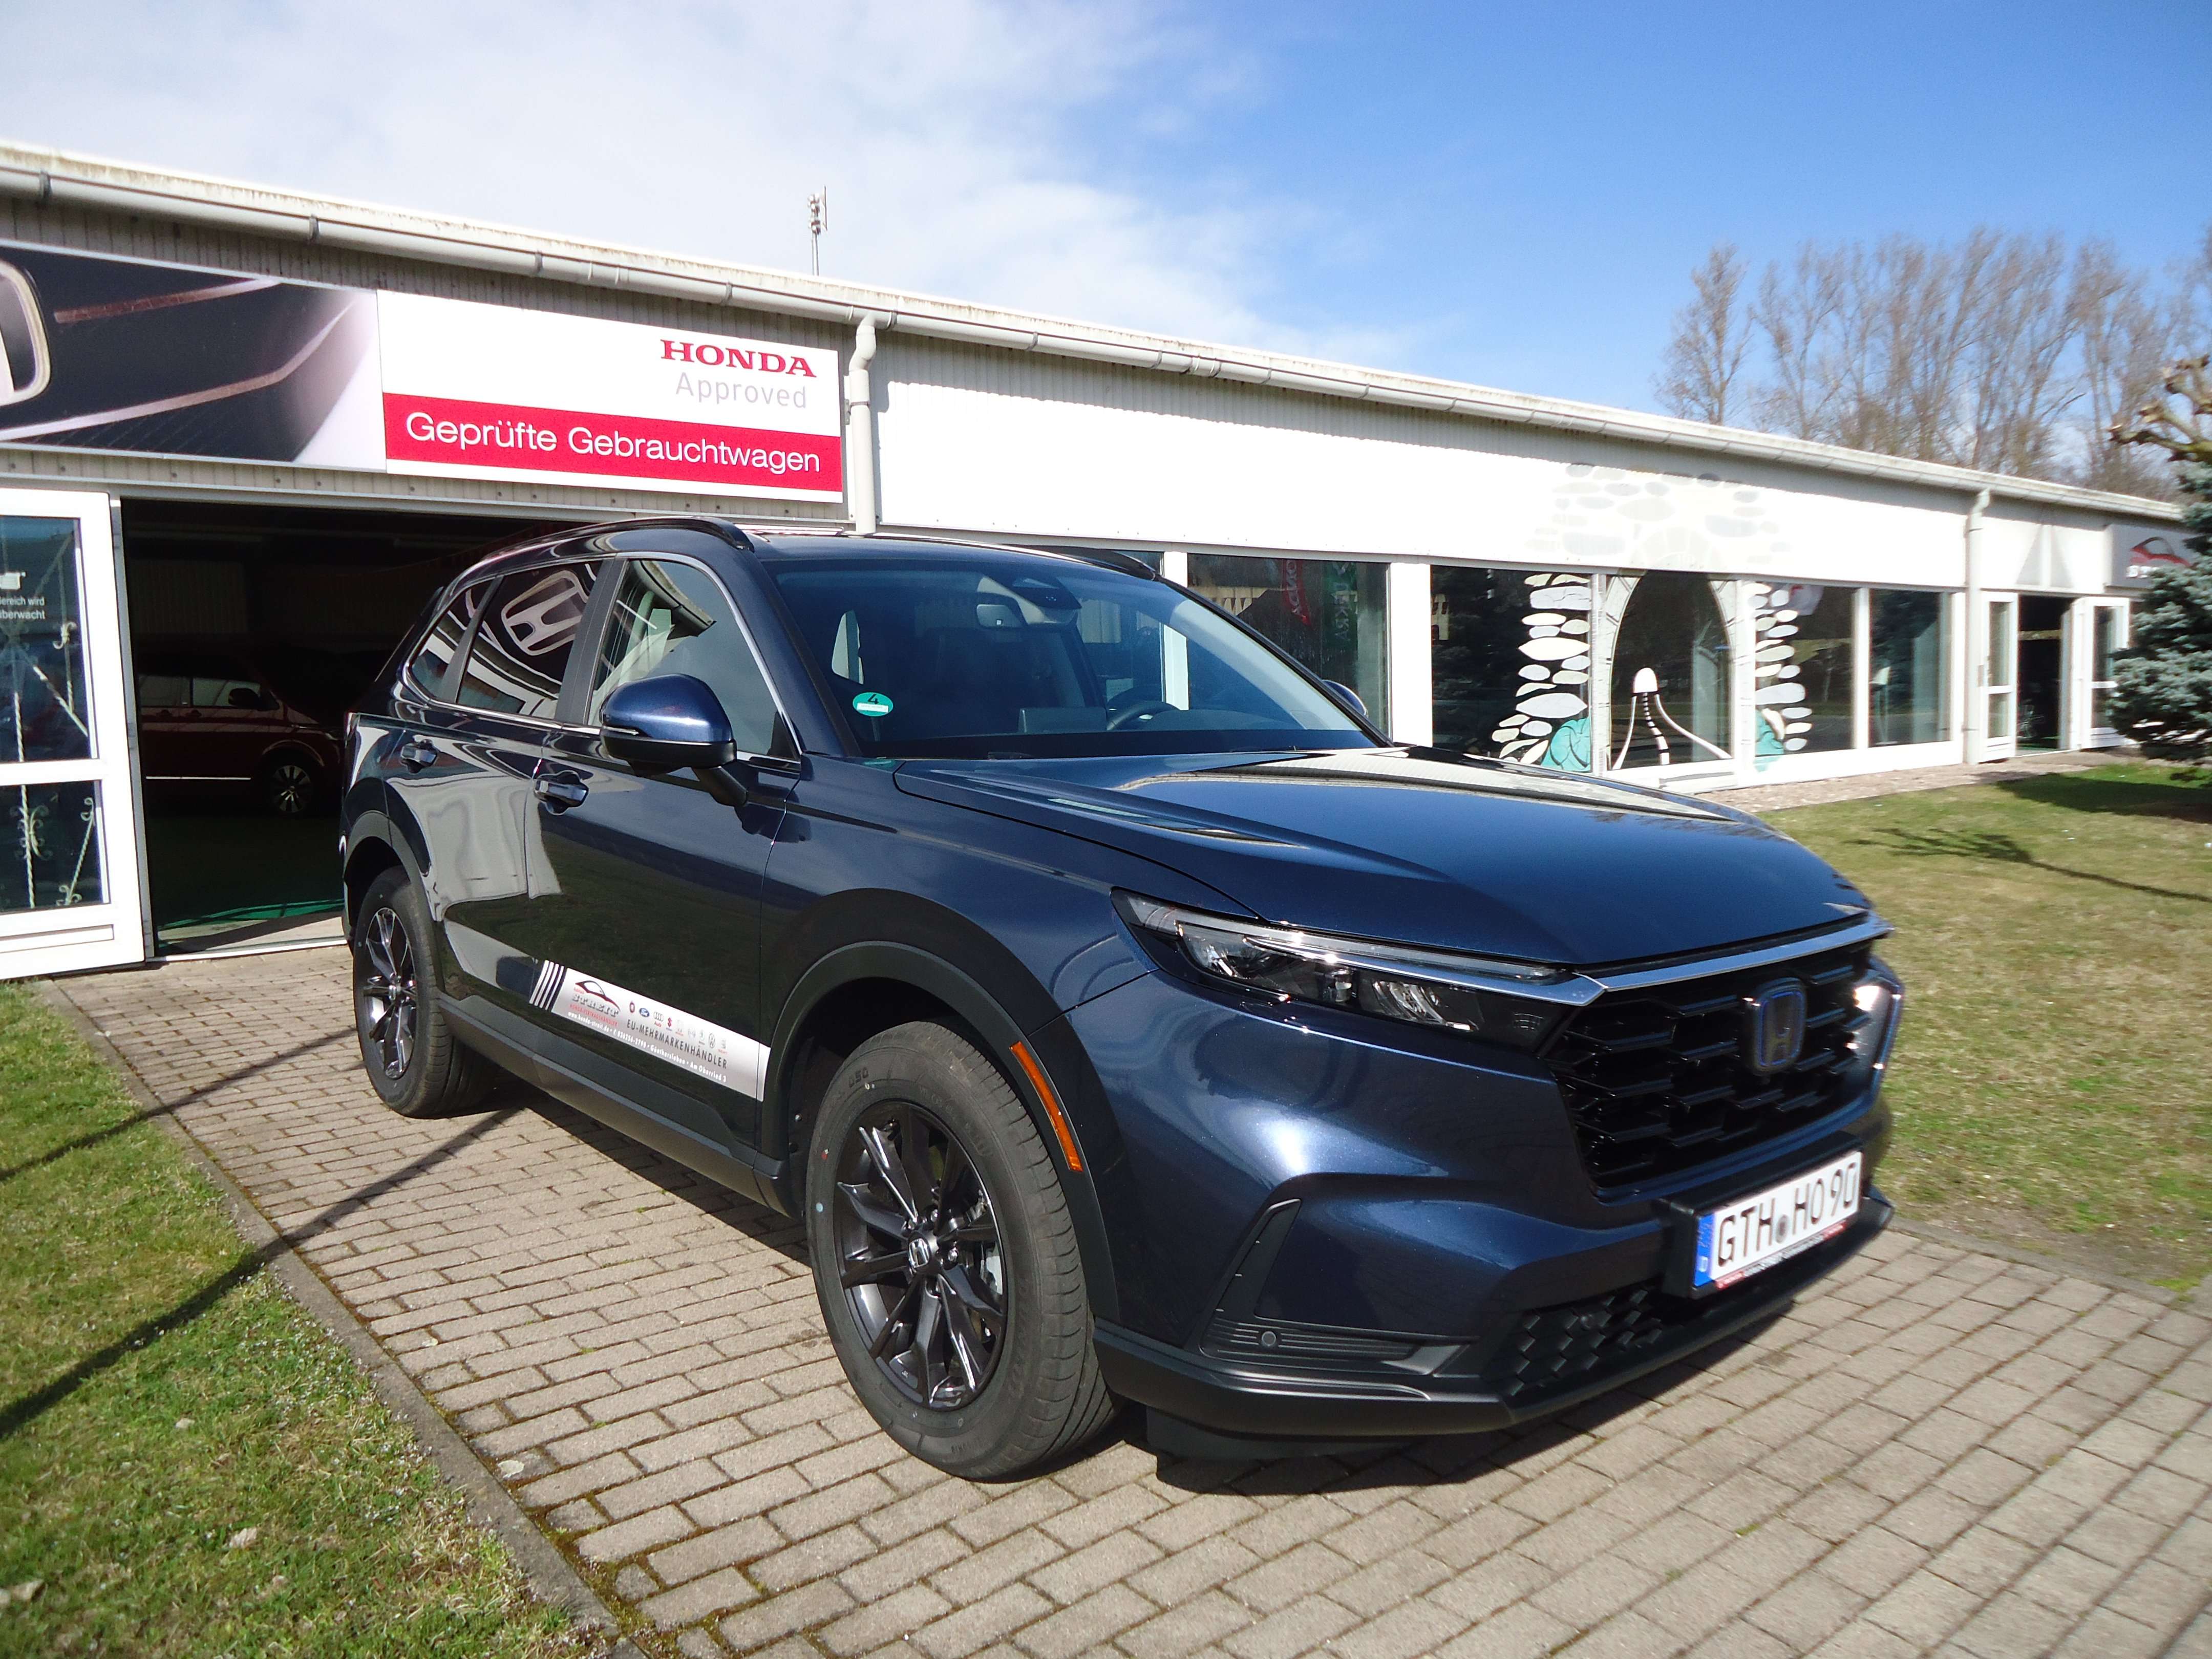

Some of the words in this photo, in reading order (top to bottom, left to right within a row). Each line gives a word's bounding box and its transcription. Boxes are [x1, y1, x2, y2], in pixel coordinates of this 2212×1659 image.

[661, 339, 817, 378] HONDA
[676, 372, 807, 409] Approved
[406, 412, 557, 451] Geprüfte
[568, 426, 821, 476] Gebrauchtwagen
[0, 595, 26, 606] ereich
[867, 693, 880, 705] 4
[627, 1018, 728, 1070] EU-MEHRMARKENHÄNDLER
[1718, 1198, 1775, 1267] GTH
[1793, 1178, 1825, 1235] HO
[1830, 1162, 1858, 1217] 90
